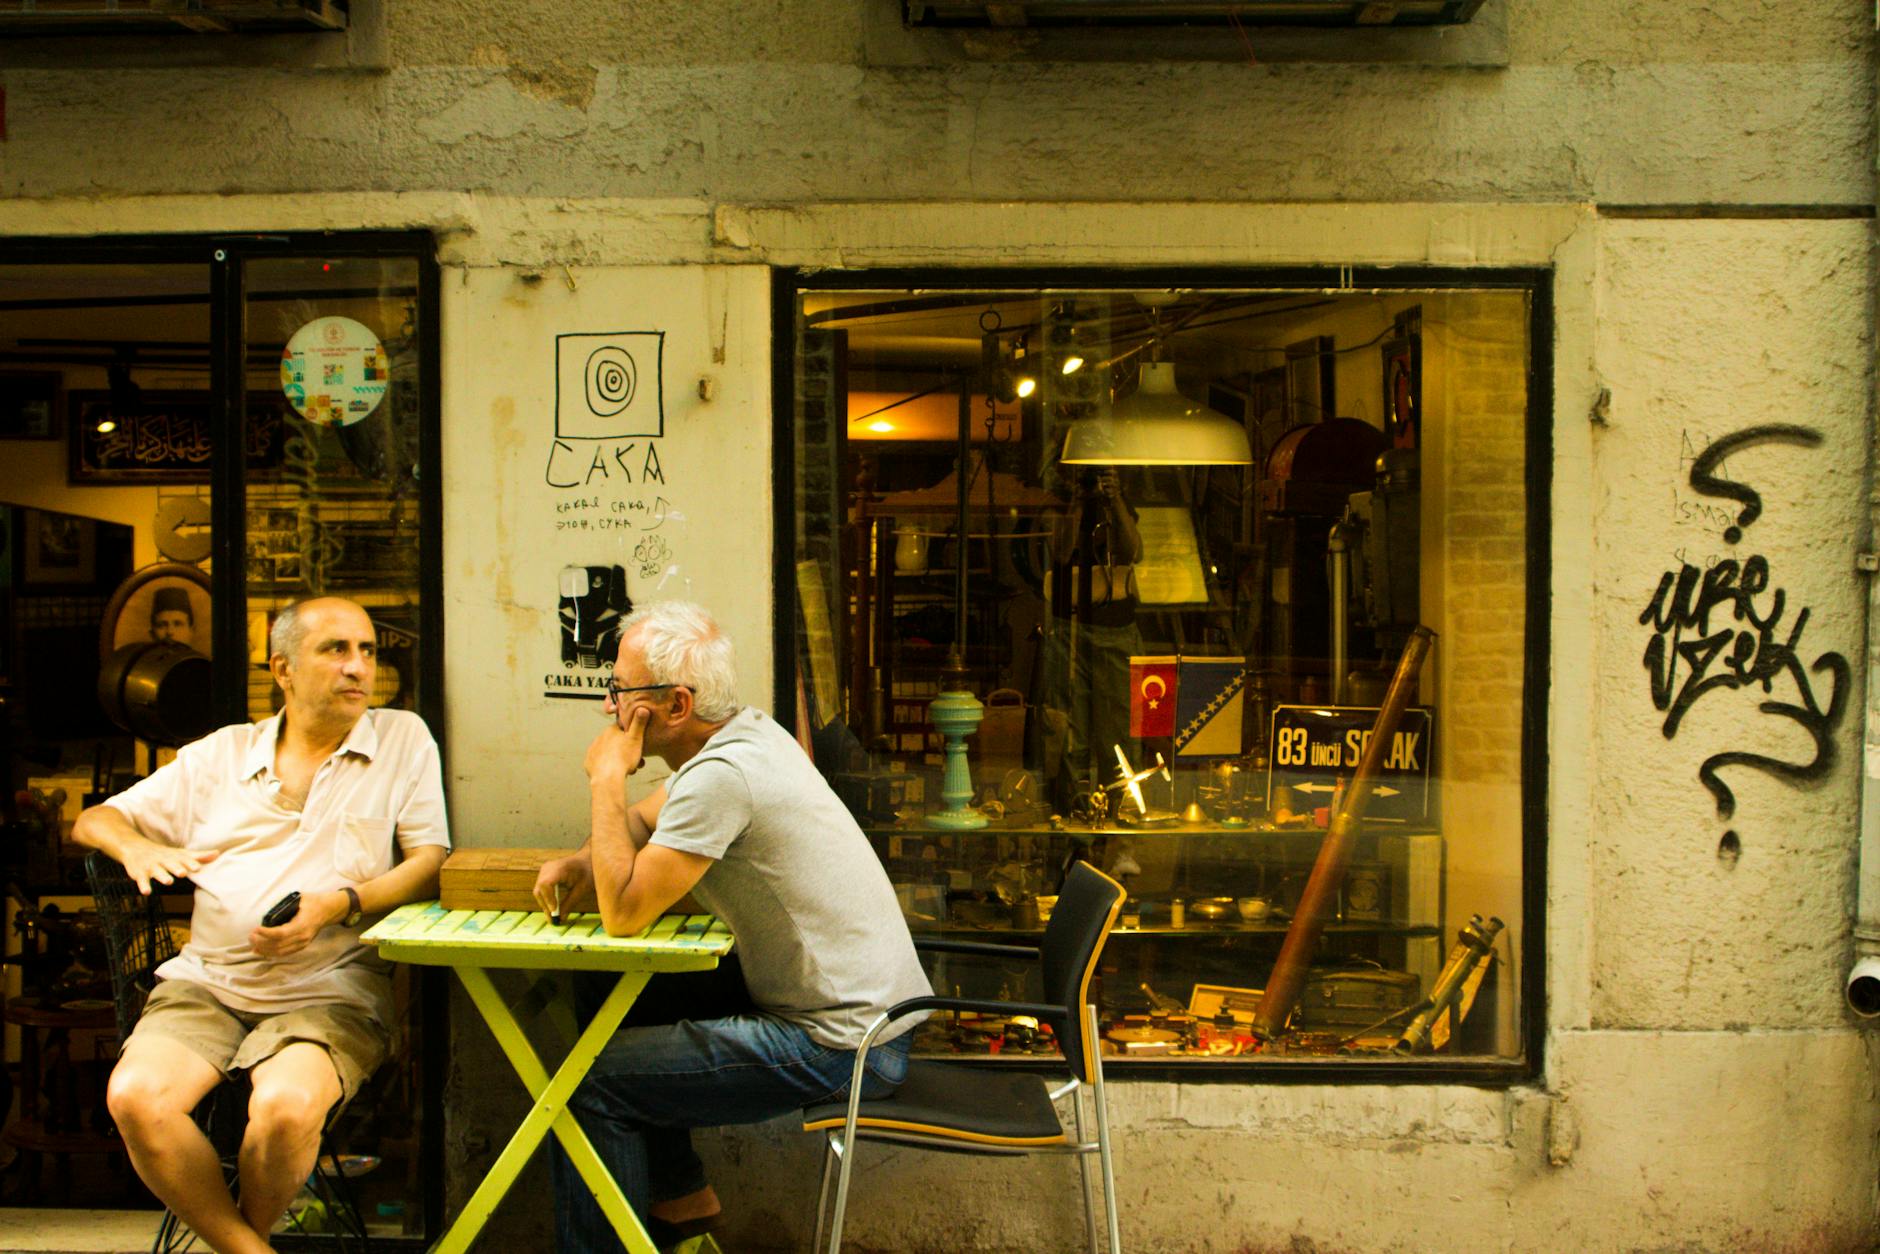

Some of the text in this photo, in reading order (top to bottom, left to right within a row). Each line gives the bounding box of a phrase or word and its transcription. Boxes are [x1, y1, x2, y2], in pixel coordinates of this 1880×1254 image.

[545, 674, 582, 689] ÇAKA
[1277, 727, 1421, 771] 83 ÜNCÜ SAK
